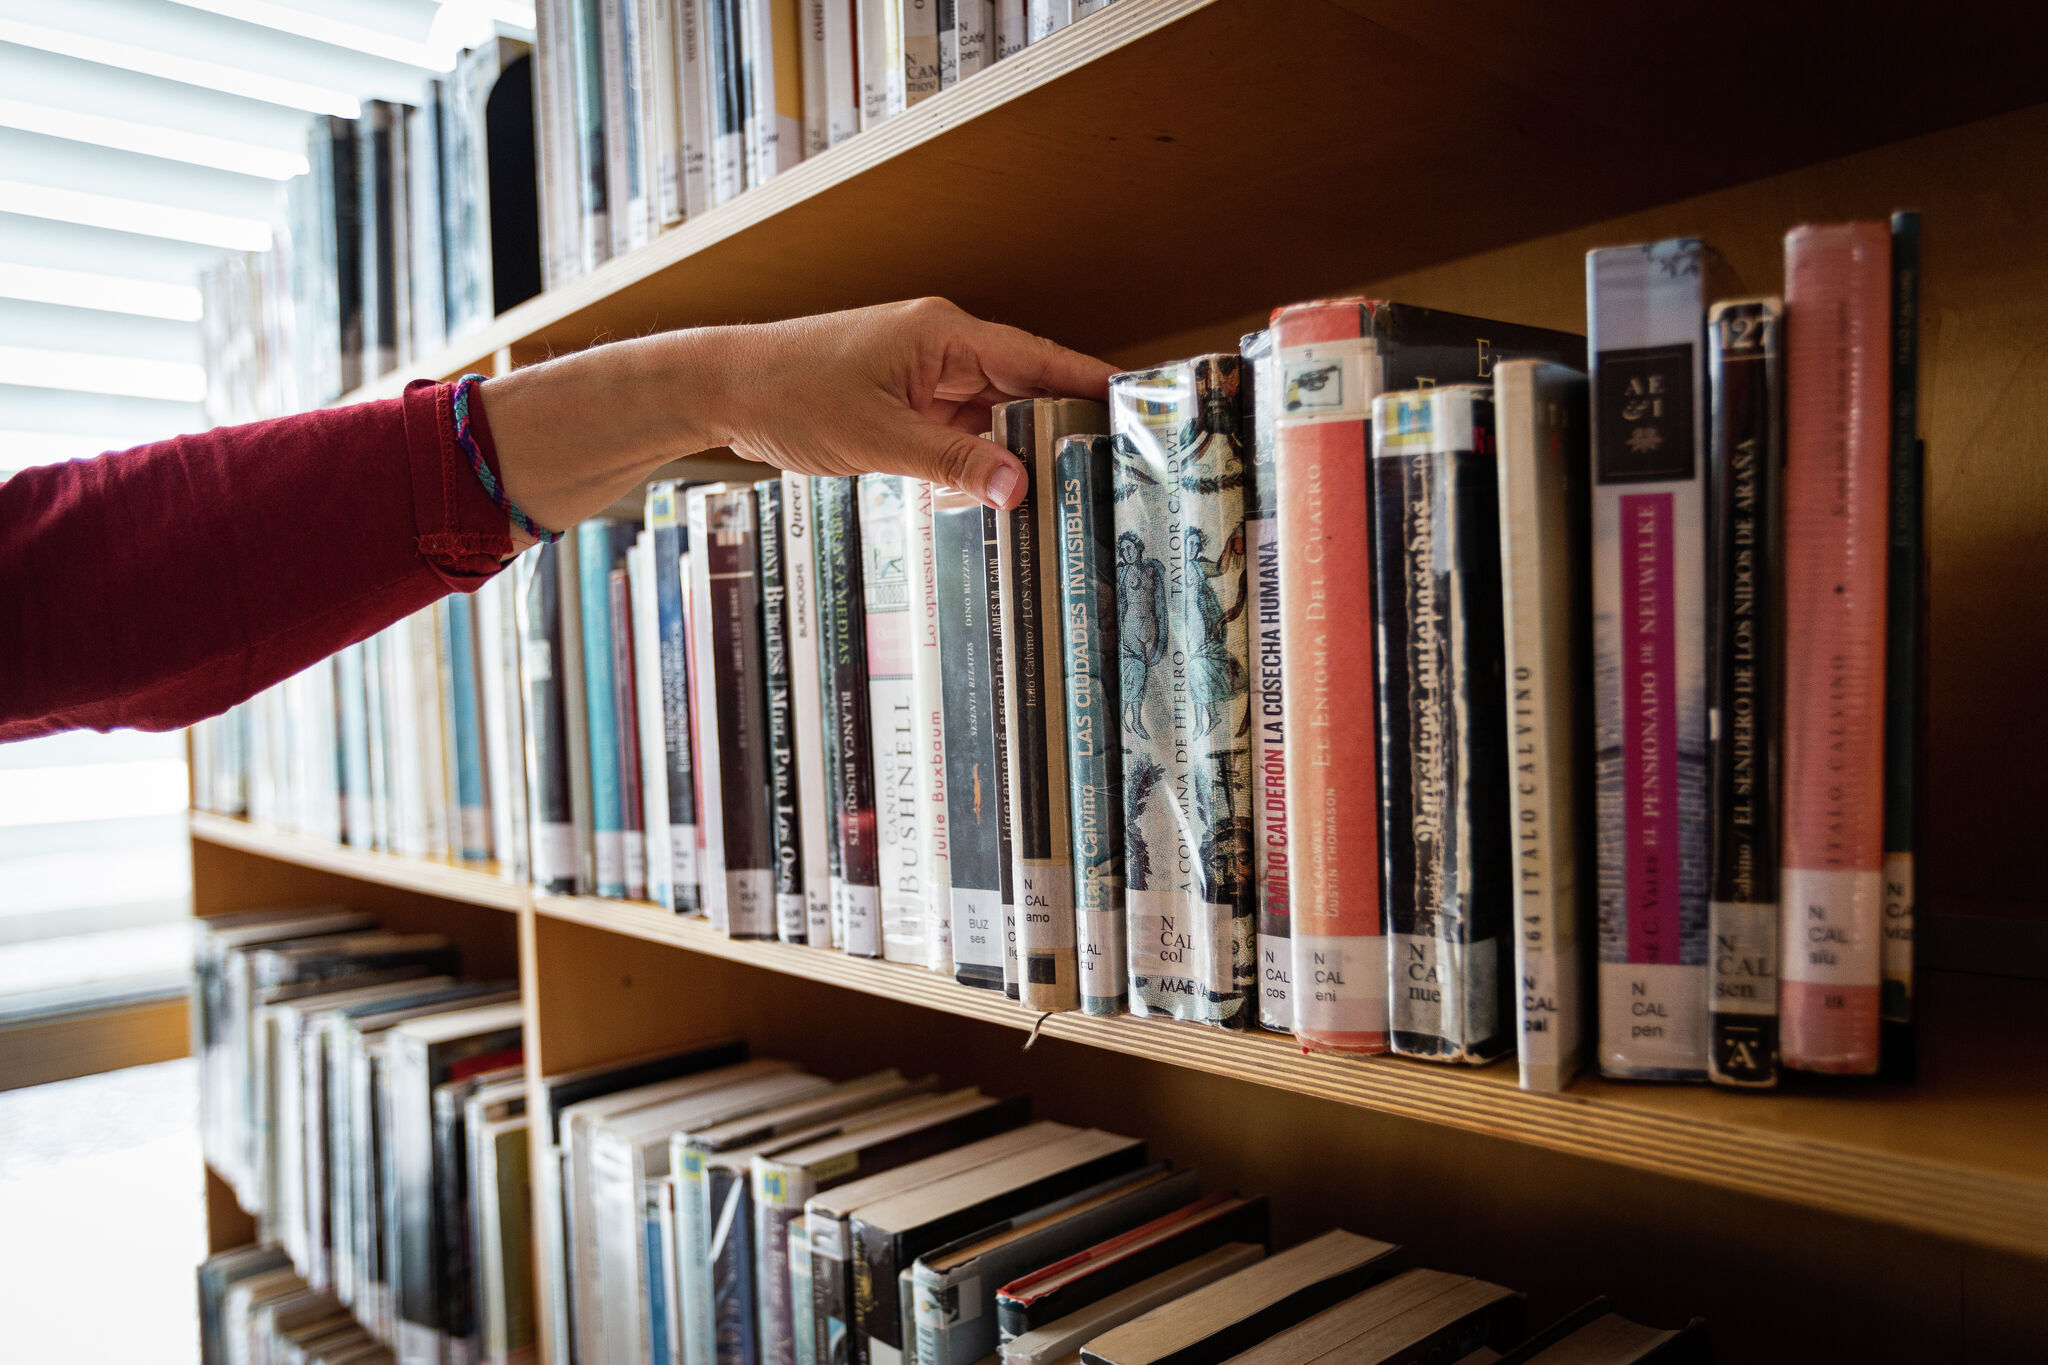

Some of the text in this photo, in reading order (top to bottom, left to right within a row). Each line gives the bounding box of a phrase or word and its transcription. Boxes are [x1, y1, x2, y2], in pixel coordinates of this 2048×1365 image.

[1720, 317, 1774, 350] 127
[1731, 438, 1757, 511] ARAÑA
[790, 481, 804, 538] Queer
[918, 526, 931, 542] al
[1064, 478, 1086, 595] INVISIBLES
[1734, 518, 1756, 545] DE
[1018, 523, 1031, 588] AMORES
[1167, 522, 1183, 598] TAYLOR
[834, 572, 847, 584] A
[989, 558, 1000, 583] CAIN
[1637, 504, 1657, 634] NEUWELKE
[1733, 550, 1756, 614] NIDOS
[922, 547, 938, 620] opuesto
[961, 548, 973, 627] DINO BUZZATI
[795, 563, 808, 638] BURROUGHS
[1020, 591, 1033, 620] LOS
[835, 589, 851, 665] MEDIAS
[992, 602, 1003, 639] JAMES
[1303, 463, 1331, 768] EL ENIGMA DEL CUATRO
[923, 624, 937, 648] Lo
[1259, 540, 1284, 744] LA COSECHA HUMANA
[1733, 620, 1755, 660] LOS
[1023, 631, 1035, 678] Calvino
[1069, 602, 1092, 708] CIUDADES
[1639, 642, 1655, 665] DE
[965, 641, 979, 737] SESENTA RELATOS
[1173, 650, 1187, 730] HIERRO
[1734, 666, 1754, 692] DE
[1024, 680, 1036, 707] Italo
[1076, 711, 1093, 756] LAS
[1514, 666, 1538, 796] CALVINO
[1175, 739, 1188, 764] DE
[1639, 671, 1661, 818] PENSIONADO
[1733, 697, 1755, 796] SENDERO
[840, 691, 860, 847] BLANCA BUSQUETS
[1825, 655, 1845, 865] ITALO CALVINO
[894, 696, 920, 894] BUSHNELL
[930, 710, 949, 861] Julie Buxbaum
[1080, 785, 1099, 857] Calvino
[1734, 800, 1754, 826] EL
[1263, 750, 1290, 916] EMILIO CALDERÓN
[1643, 824, 1658, 846] EL
[1311, 820, 1323, 889] CALDWELL
[1325, 788, 1339, 917] DUSTIN THOMASON
[1518, 808, 1541, 896] ITALO
[1024, 879, 1033, 890] N
[968, 904, 976, 914] N
[1025, 896, 1049, 907] CAL
[1808, 906, 1825, 919] N
[969, 919, 989, 930] BUZ
[1026, 913, 1050, 923] amo
[1161, 915, 1175, 931] N
[970, 936, 986, 944] ses
[1160, 931, 1195, 950] CAL
[1717, 935, 1735, 953] N
[1808, 928, 1849, 944] CAL
[1160, 948, 1183, 963] col
[1265, 951, 1274, 963] N
[1315, 952, 1325, 964] N
[1409, 943, 1426, 961] N
[1265, 968, 1291, 983] CAL
[1315, 970, 1345, 984] CAL
[1716, 955, 1773, 978] CAL
[1266, 988, 1286, 999] cos
[1408, 985, 1441, 1003] nue
[1522, 976, 1536, 991] N
[1632, 983, 1644, 995] N
[1716, 982, 1756, 999] sen
[1315, 991, 1337, 1003] eni
[1522, 996, 1557, 1012] CAL
[1631, 1002, 1667, 1017] CAL
[1631, 1023, 1662, 1039] pen
